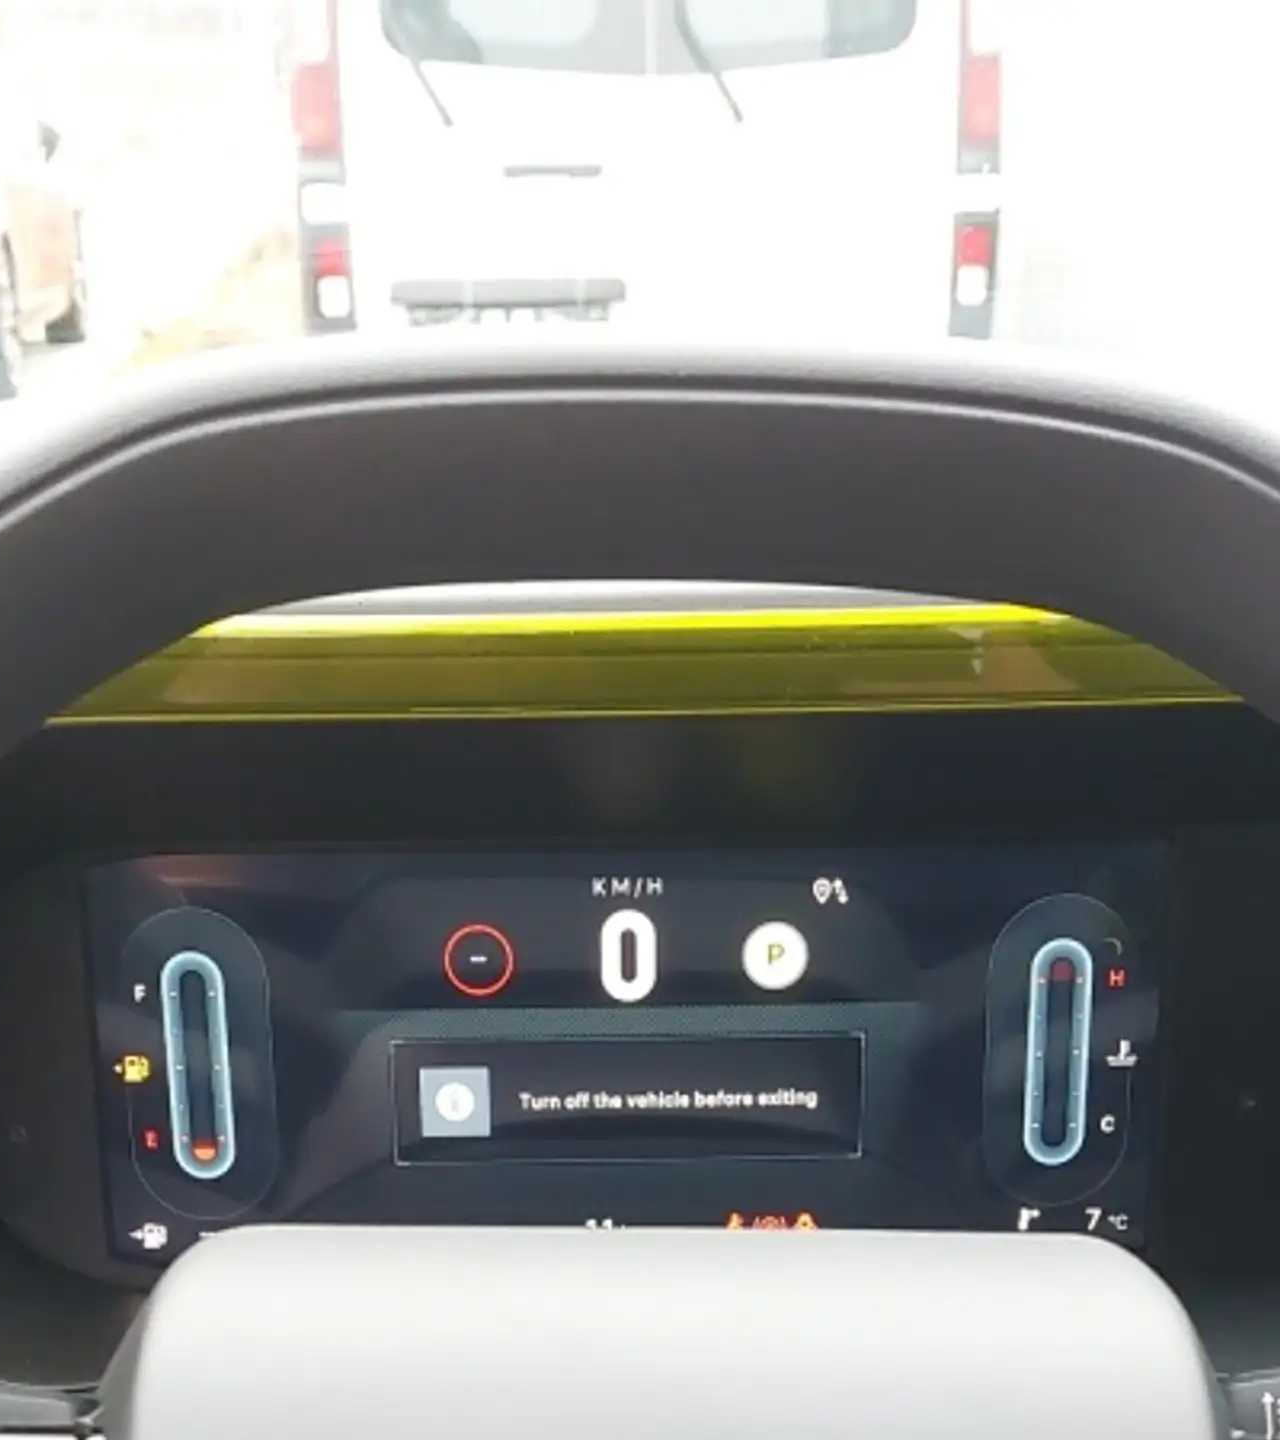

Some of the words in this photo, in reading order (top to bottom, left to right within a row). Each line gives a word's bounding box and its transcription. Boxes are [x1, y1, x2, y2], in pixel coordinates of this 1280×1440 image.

[592, 877, 663, 898] KM/H
[600, 908, 658, 1002] 0
[767, 943, 784, 965] P
[1108, 969, 1126, 987] H
[518, 1091, 562, 1111] Turn
[563, 1090, 590, 1110] off
[593, 1090, 623, 1110] the
[625, 1089, 691, 1110] vehicle
[694, 1088, 754, 1109] before
[758, 1087, 819, 1111] exiting
